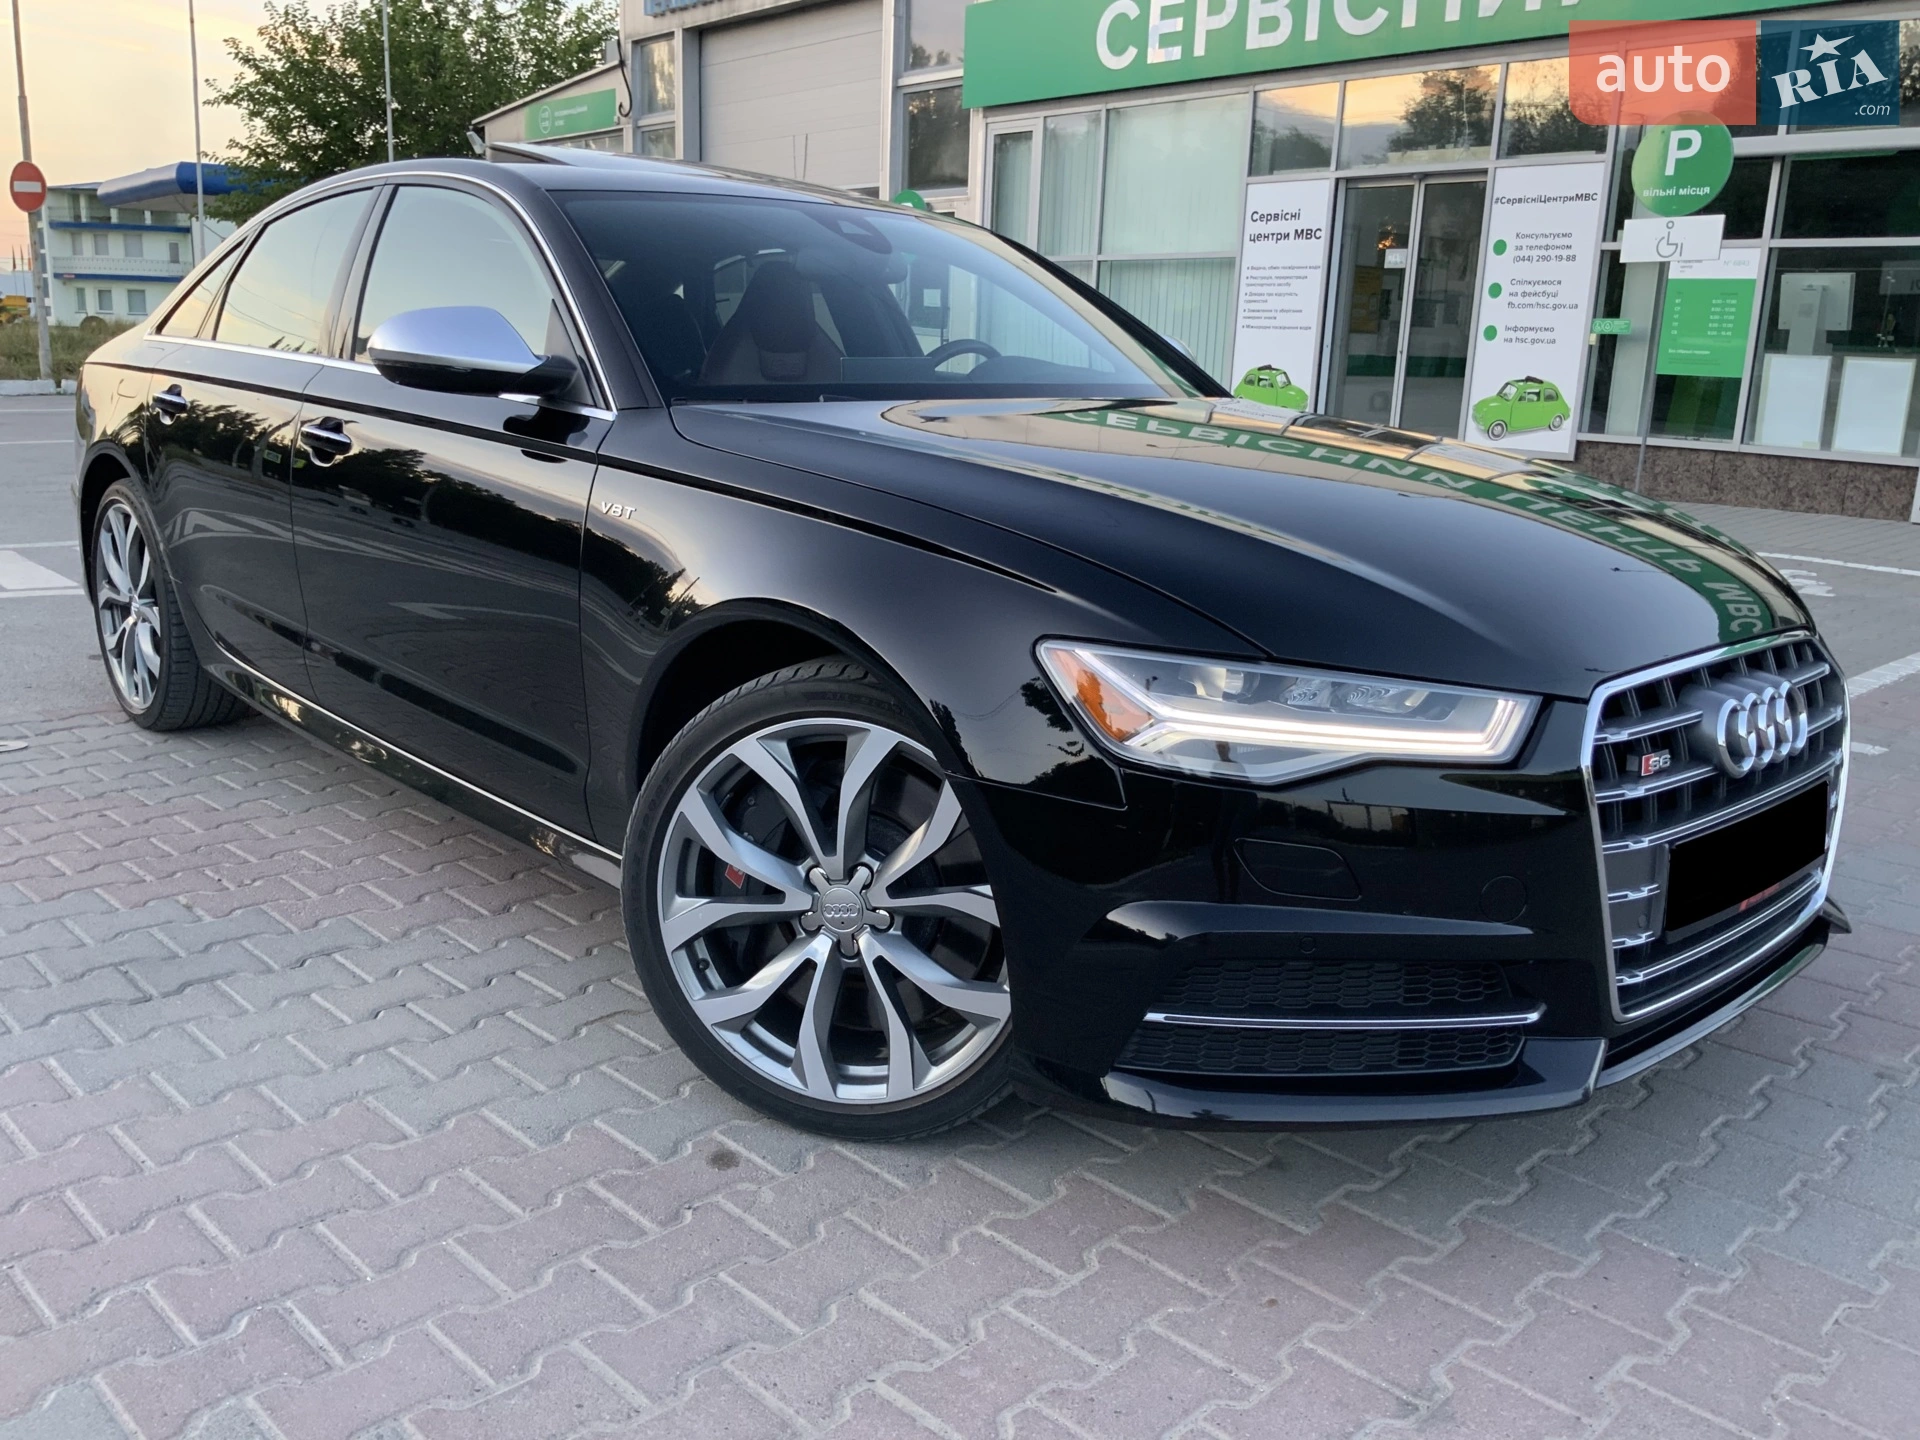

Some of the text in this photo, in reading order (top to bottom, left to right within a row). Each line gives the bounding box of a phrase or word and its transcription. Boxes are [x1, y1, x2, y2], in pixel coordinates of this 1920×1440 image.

[1096, 0, 1580, 70] СЕРВІС
[1665, 129, 1702, 176] P
[1643, 185, 1710, 197] вільні місця
[1494, 192, 1599, 206] #СервісніЦентриМВС
[1250, 208, 1301, 225] Сервісні
[1249, 228, 1322, 244] центри МВС
[1515, 232, 1573, 240] Консультуємо
[1525, 243, 1572, 252] телефоном
[1512, 254, 1577, 264] (044) 290-19-88
[1510, 278, 1562, 287] Спілкуємося
[1520, 290, 1559, 299] фейсбуці
[1507, 301, 1579, 311] fb.com/hsc.gov.ua
[1504, 325, 1555, 333] Інформуємо
[1515, 336, 1556, 345] hsc.gov.ua
